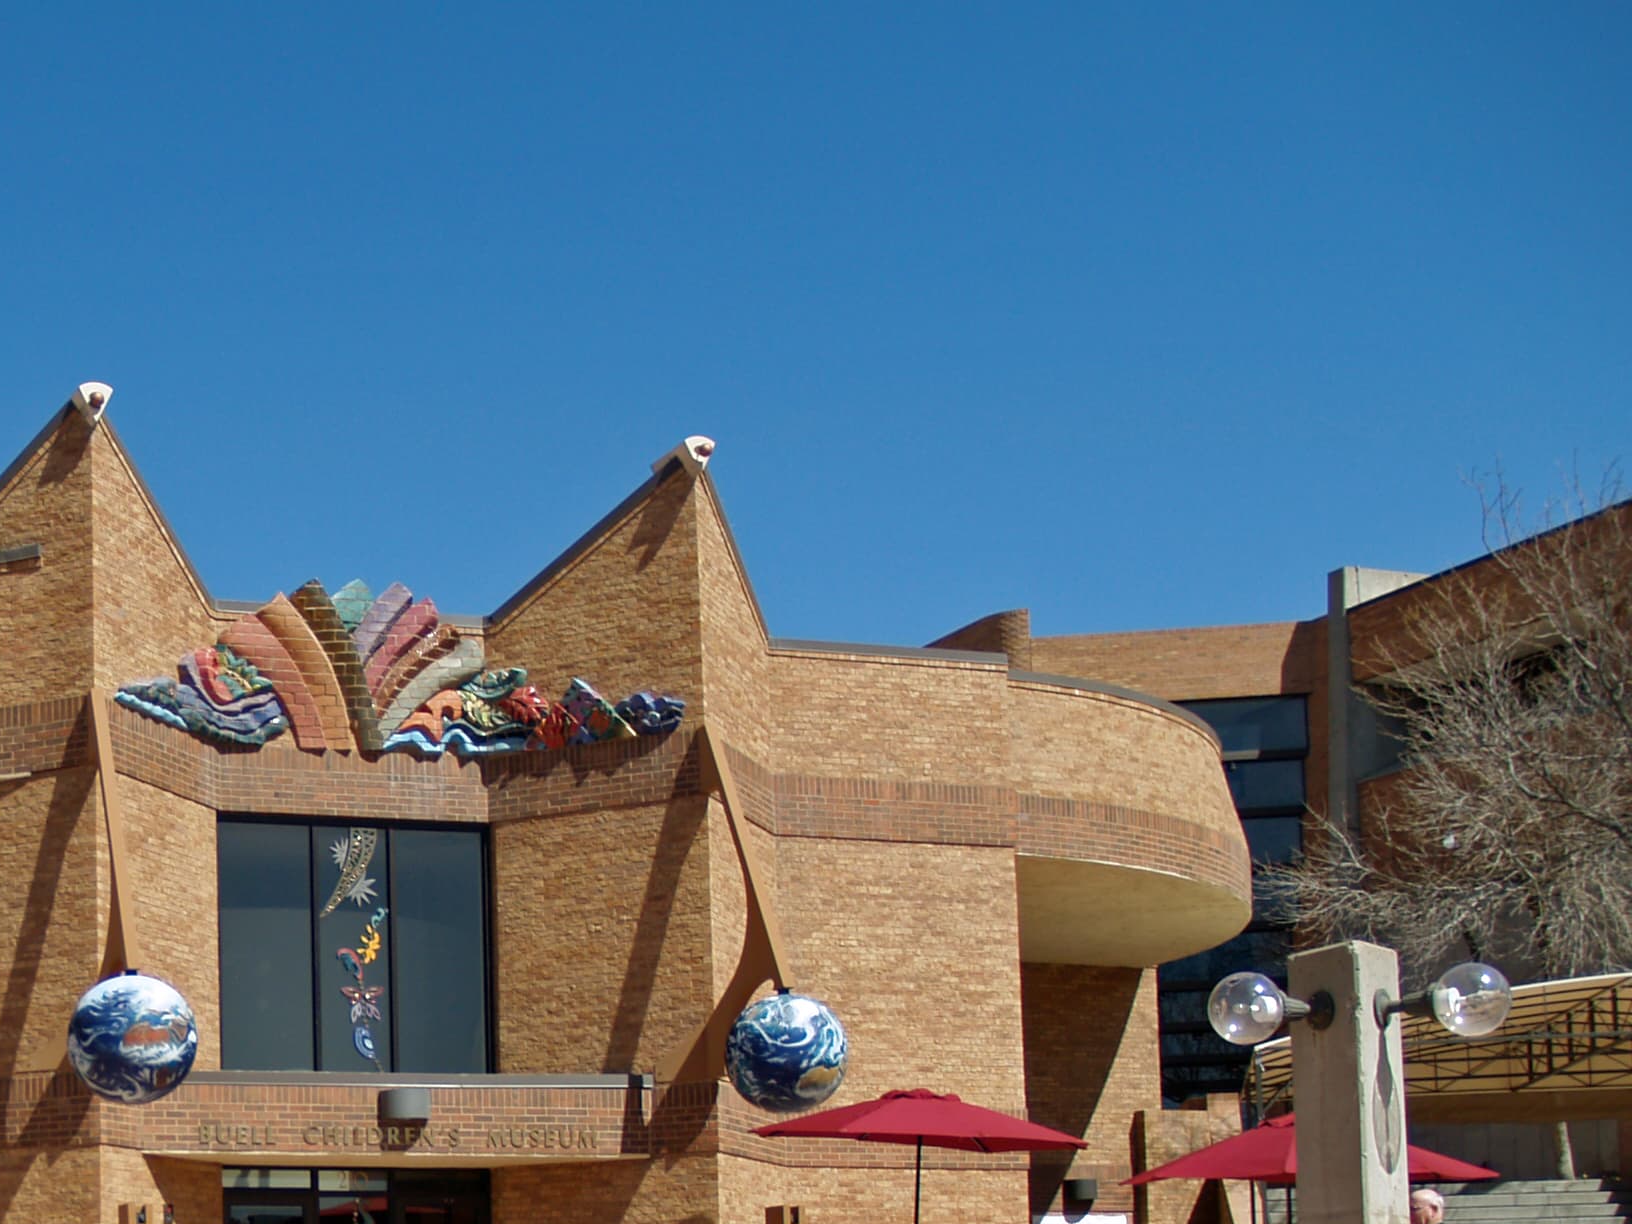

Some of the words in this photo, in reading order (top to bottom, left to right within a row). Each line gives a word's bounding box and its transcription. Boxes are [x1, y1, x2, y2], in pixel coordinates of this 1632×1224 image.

[198, 1124, 277, 1146] BUELL
[302, 1125, 461, 1149] CHILDREN'S
[486, 1127, 598, 1150] MUSEUM
